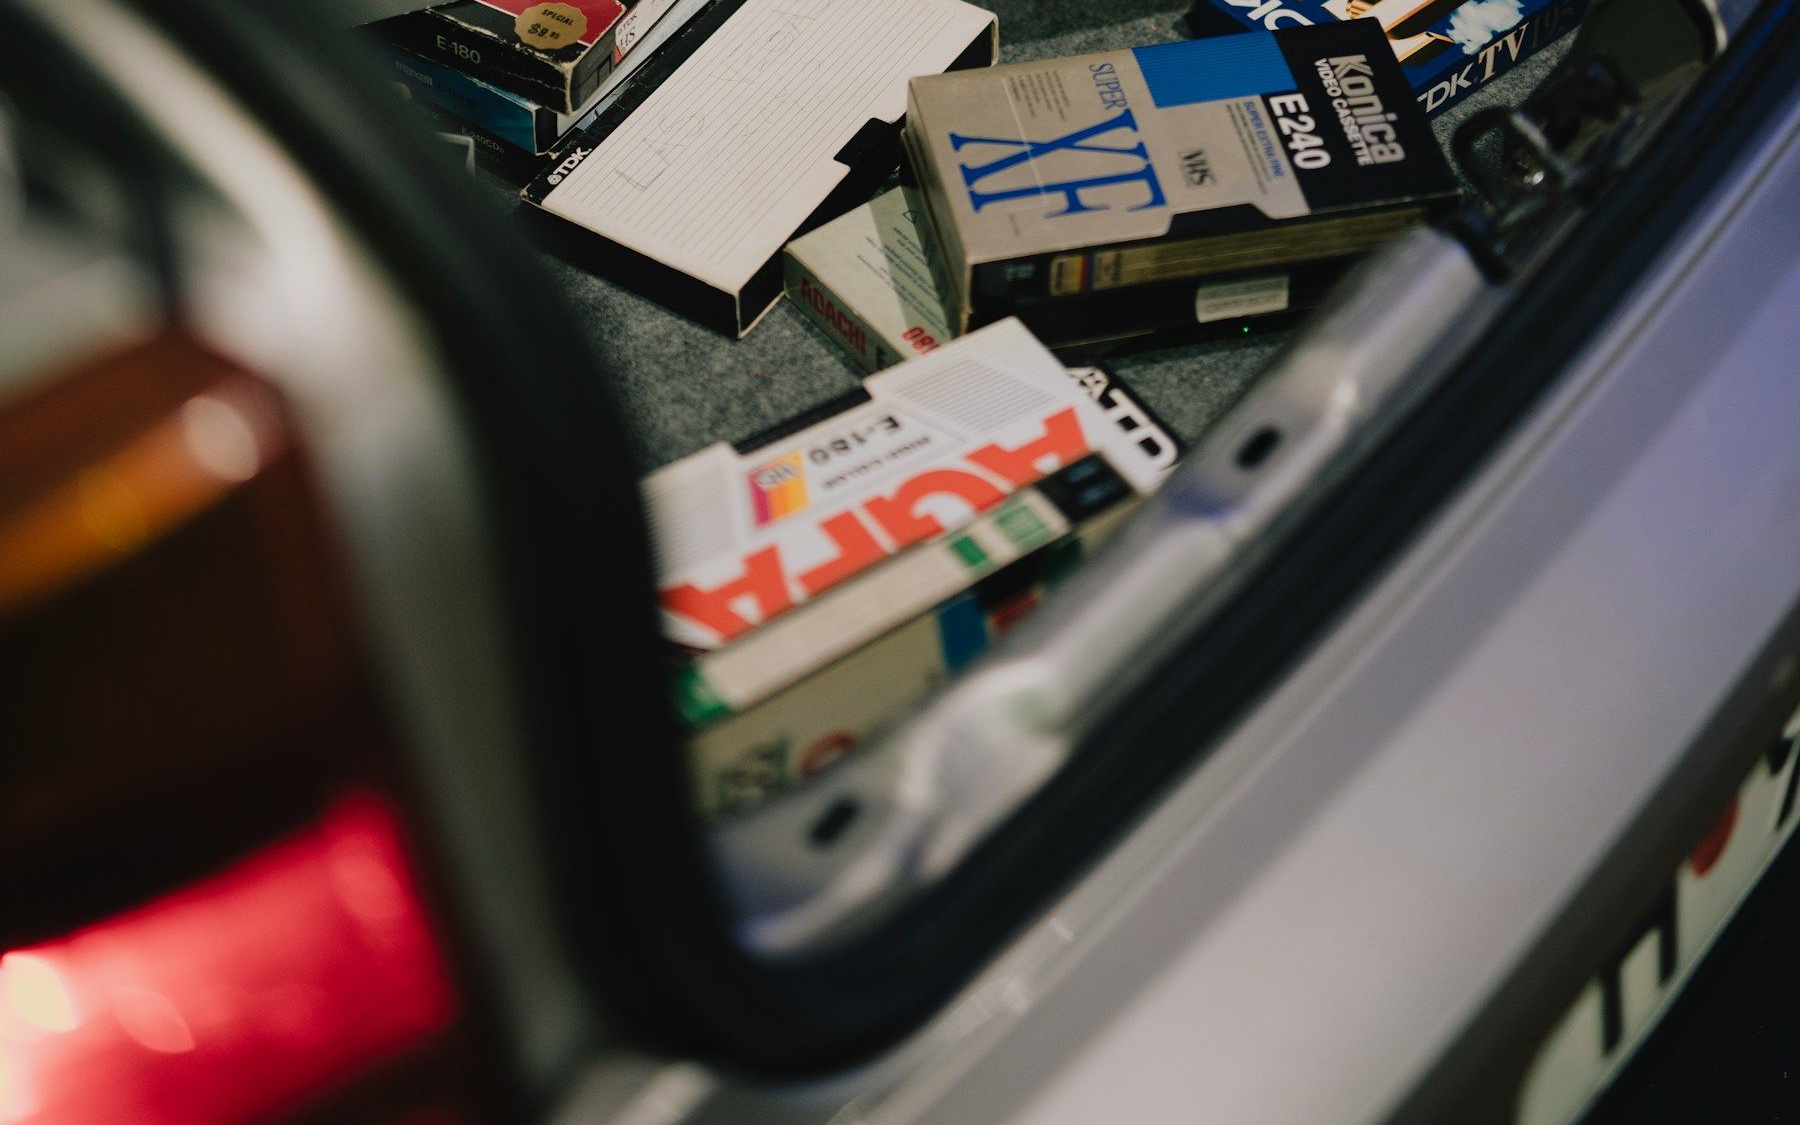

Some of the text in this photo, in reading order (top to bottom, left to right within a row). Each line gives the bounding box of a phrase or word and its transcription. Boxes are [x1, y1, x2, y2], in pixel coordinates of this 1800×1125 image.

[541, 8, 575, 27] SPECIAL
[436, 35, 481, 65] E-180
[1476, 23, 1531, 83] TV
[1088, 62, 1128, 112] SUPER
[1313, 57, 1375, 167] VIDEO CASSETTE
[1327, 53, 1407, 165] Konica
[554, 146, 592, 176] TDK
[1268, 92, 1332, 170] E240
[948, 108, 1168, 219] XF
[808, 415, 900, 466] E-180
[657, 405, 1089, 645] AGFA
